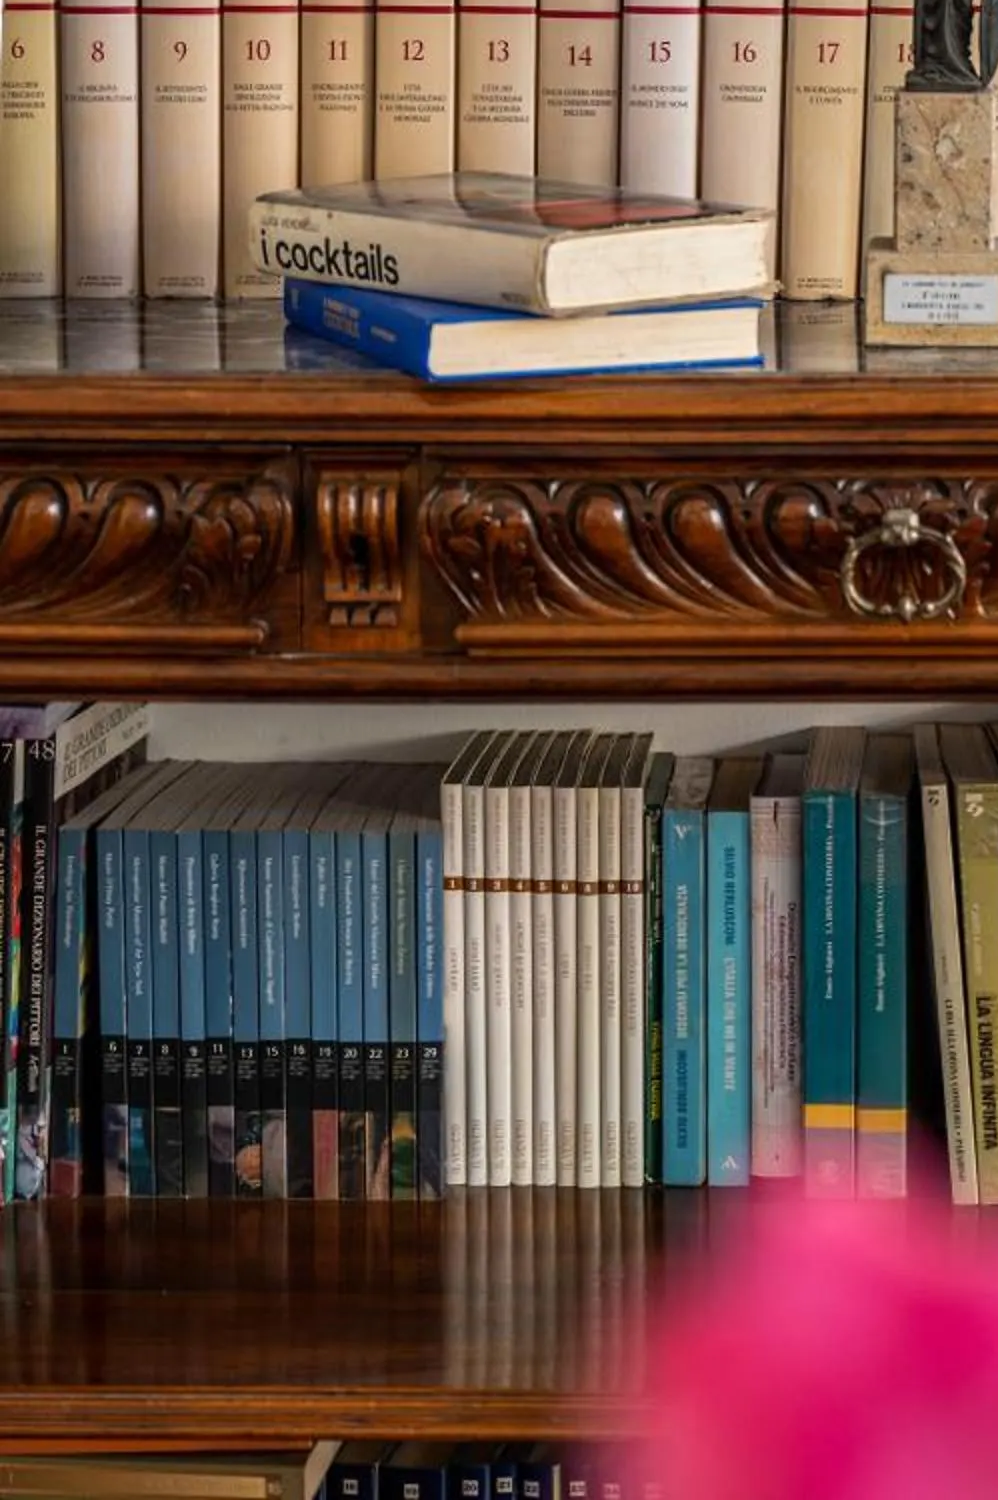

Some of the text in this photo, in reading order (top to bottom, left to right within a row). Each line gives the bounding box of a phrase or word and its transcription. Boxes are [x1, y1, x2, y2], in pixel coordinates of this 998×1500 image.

[11, 38, 25, 58] 6
[91, 41, 105, 62] 8
[174, 41, 188, 62] 9
[245, 40, 271, 61] 10
[328, 40, 348, 61] 11
[402, 40, 424, 61] 12
[487, 40, 509, 62] 13
[568, 46, 592, 66] 14
[649, 41, 671, 62] 15
[733, 41, 757, 63] 16
[818, 43, 840, 63] 17
[261, 229, 399, 285] i cocktails
[30, 740, 55, 760] 48
[33, 840, 46, 891] GRANDE
[724, 847, 736, 946] SILVIO BERLUSCONI
[31, 894, 45, 971] DIZIONARIO
[29, 997, 41, 1046] PITTORI
[213, 1043, 223, 1054] 11
[241, 1047, 253, 1057] 13
[267, 1046, 279, 1057] 15
[343, 1048, 358, 1059] 20
[369, 1048, 383, 1059] 22
[396, 1048, 409, 1059] 23
[424, 1047, 437, 1058] 29
[976, 996, 998, 1150] LA LINGUA INFINITA
